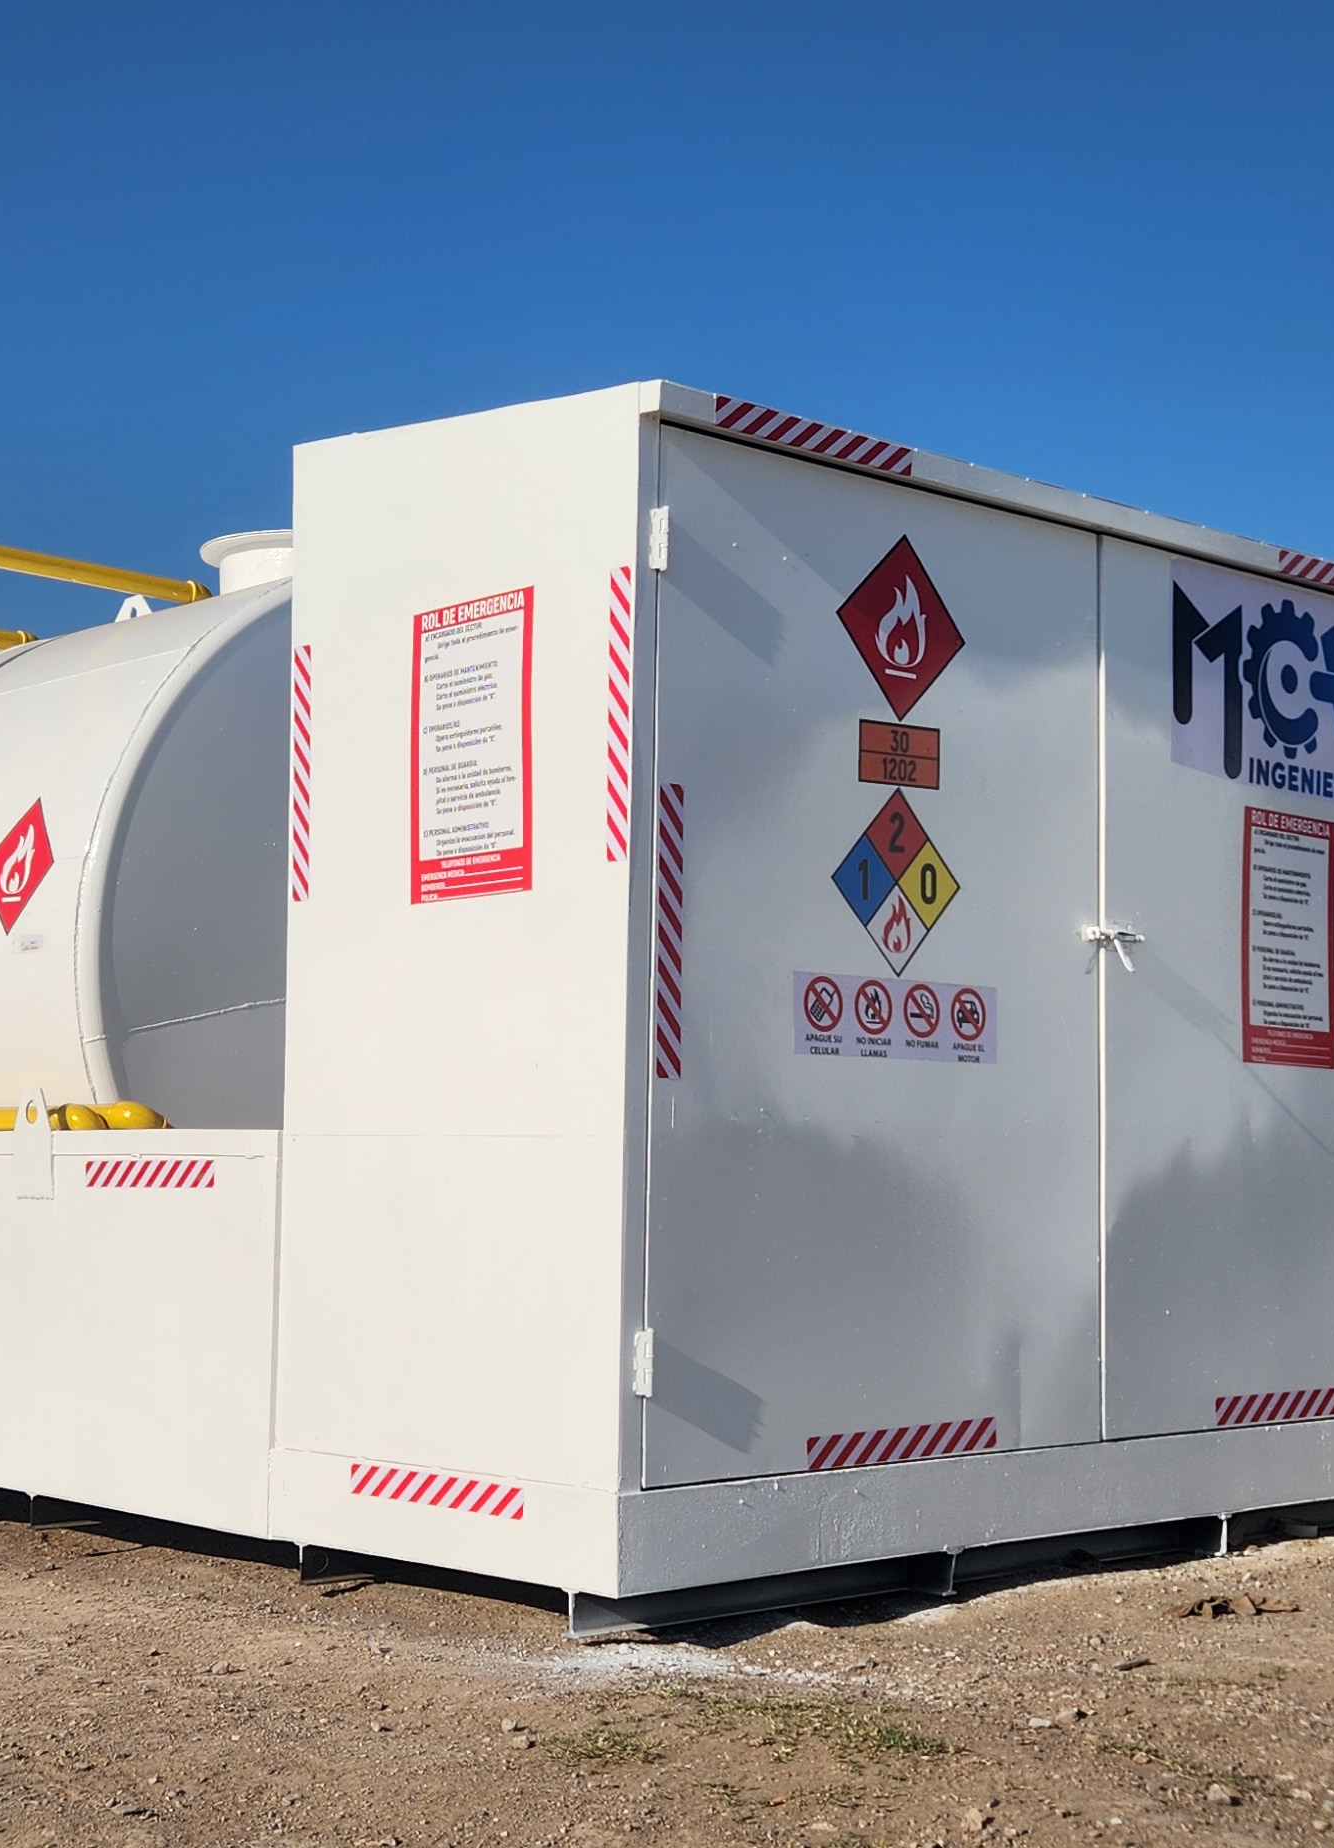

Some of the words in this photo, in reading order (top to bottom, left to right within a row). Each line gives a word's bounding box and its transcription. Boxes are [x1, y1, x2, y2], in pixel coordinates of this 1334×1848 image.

[421, 613, 441, 631] ROL
[442, 608, 456, 626] DE
[457, 590, 525, 623] EMERGENCIA
[891, 730, 909, 753] 30
[882, 757, 917, 782] 1202
[1251, 809, 1267, 826] ROL
[1268, 813, 1279, 828] DE
[1280, 815, 1330, 837] EMERGENCIA
[888, 812, 905, 853] 2
[858, 858, 869, 900] 1
[920, 863, 937, 905] 0
[805, 1033, 832, 1043] APAGUE
[833, 1035, 843, 1044] SU
[856, 1036, 866, 1045] NO
[867, 1037, 892, 1047] INICIAR
[905, 1039, 915, 1048] NO
[916, 1040, 939, 1049] FUMAR
[952, 1042, 976, 1052] APAGUE
[977, 1044, 985, 1052] EL
[810, 1046, 840, 1056] CELULAR
[860, 1048, 888, 1058] LLAMAS
[957, 1054, 980, 1064] MOTOR
